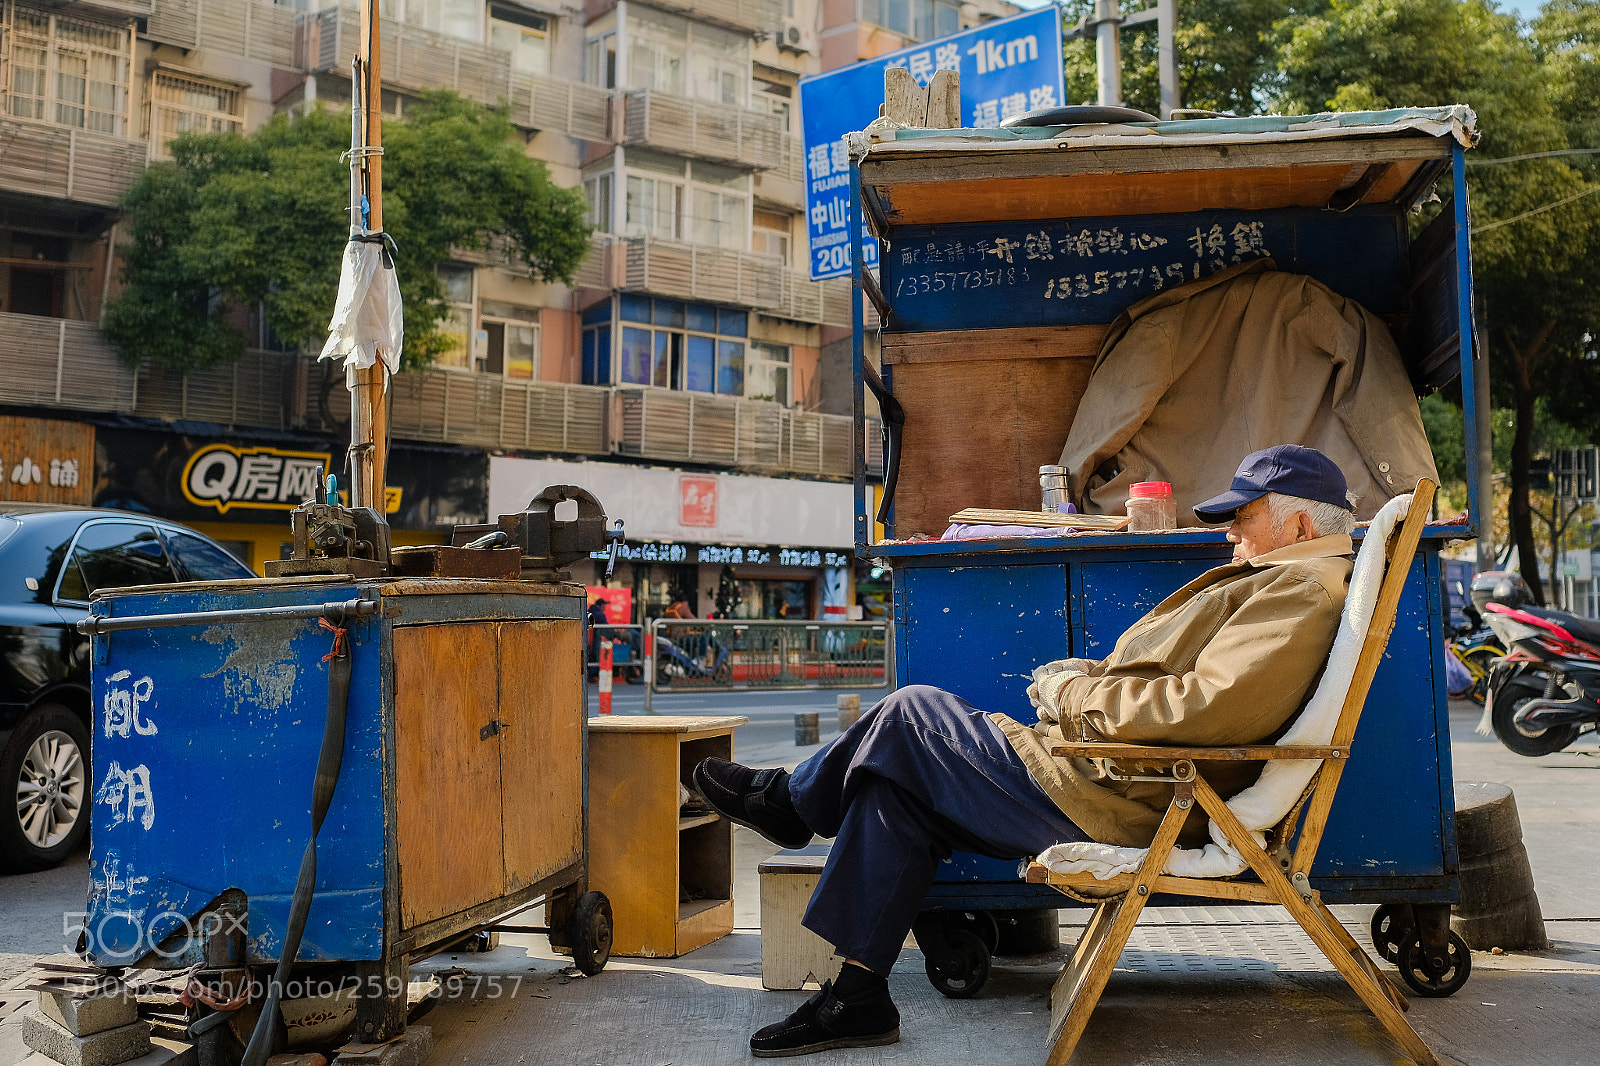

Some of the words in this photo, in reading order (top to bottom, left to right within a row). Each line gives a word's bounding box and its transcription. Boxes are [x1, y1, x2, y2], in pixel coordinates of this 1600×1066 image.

[967, 34, 1038, 75] 1km
[973, 85, 1057, 128] 福建路
[811, 196, 850, 234] 中山
[0, 457, 79, 487] 小铺
[190, 451, 324, 502] Q房网
